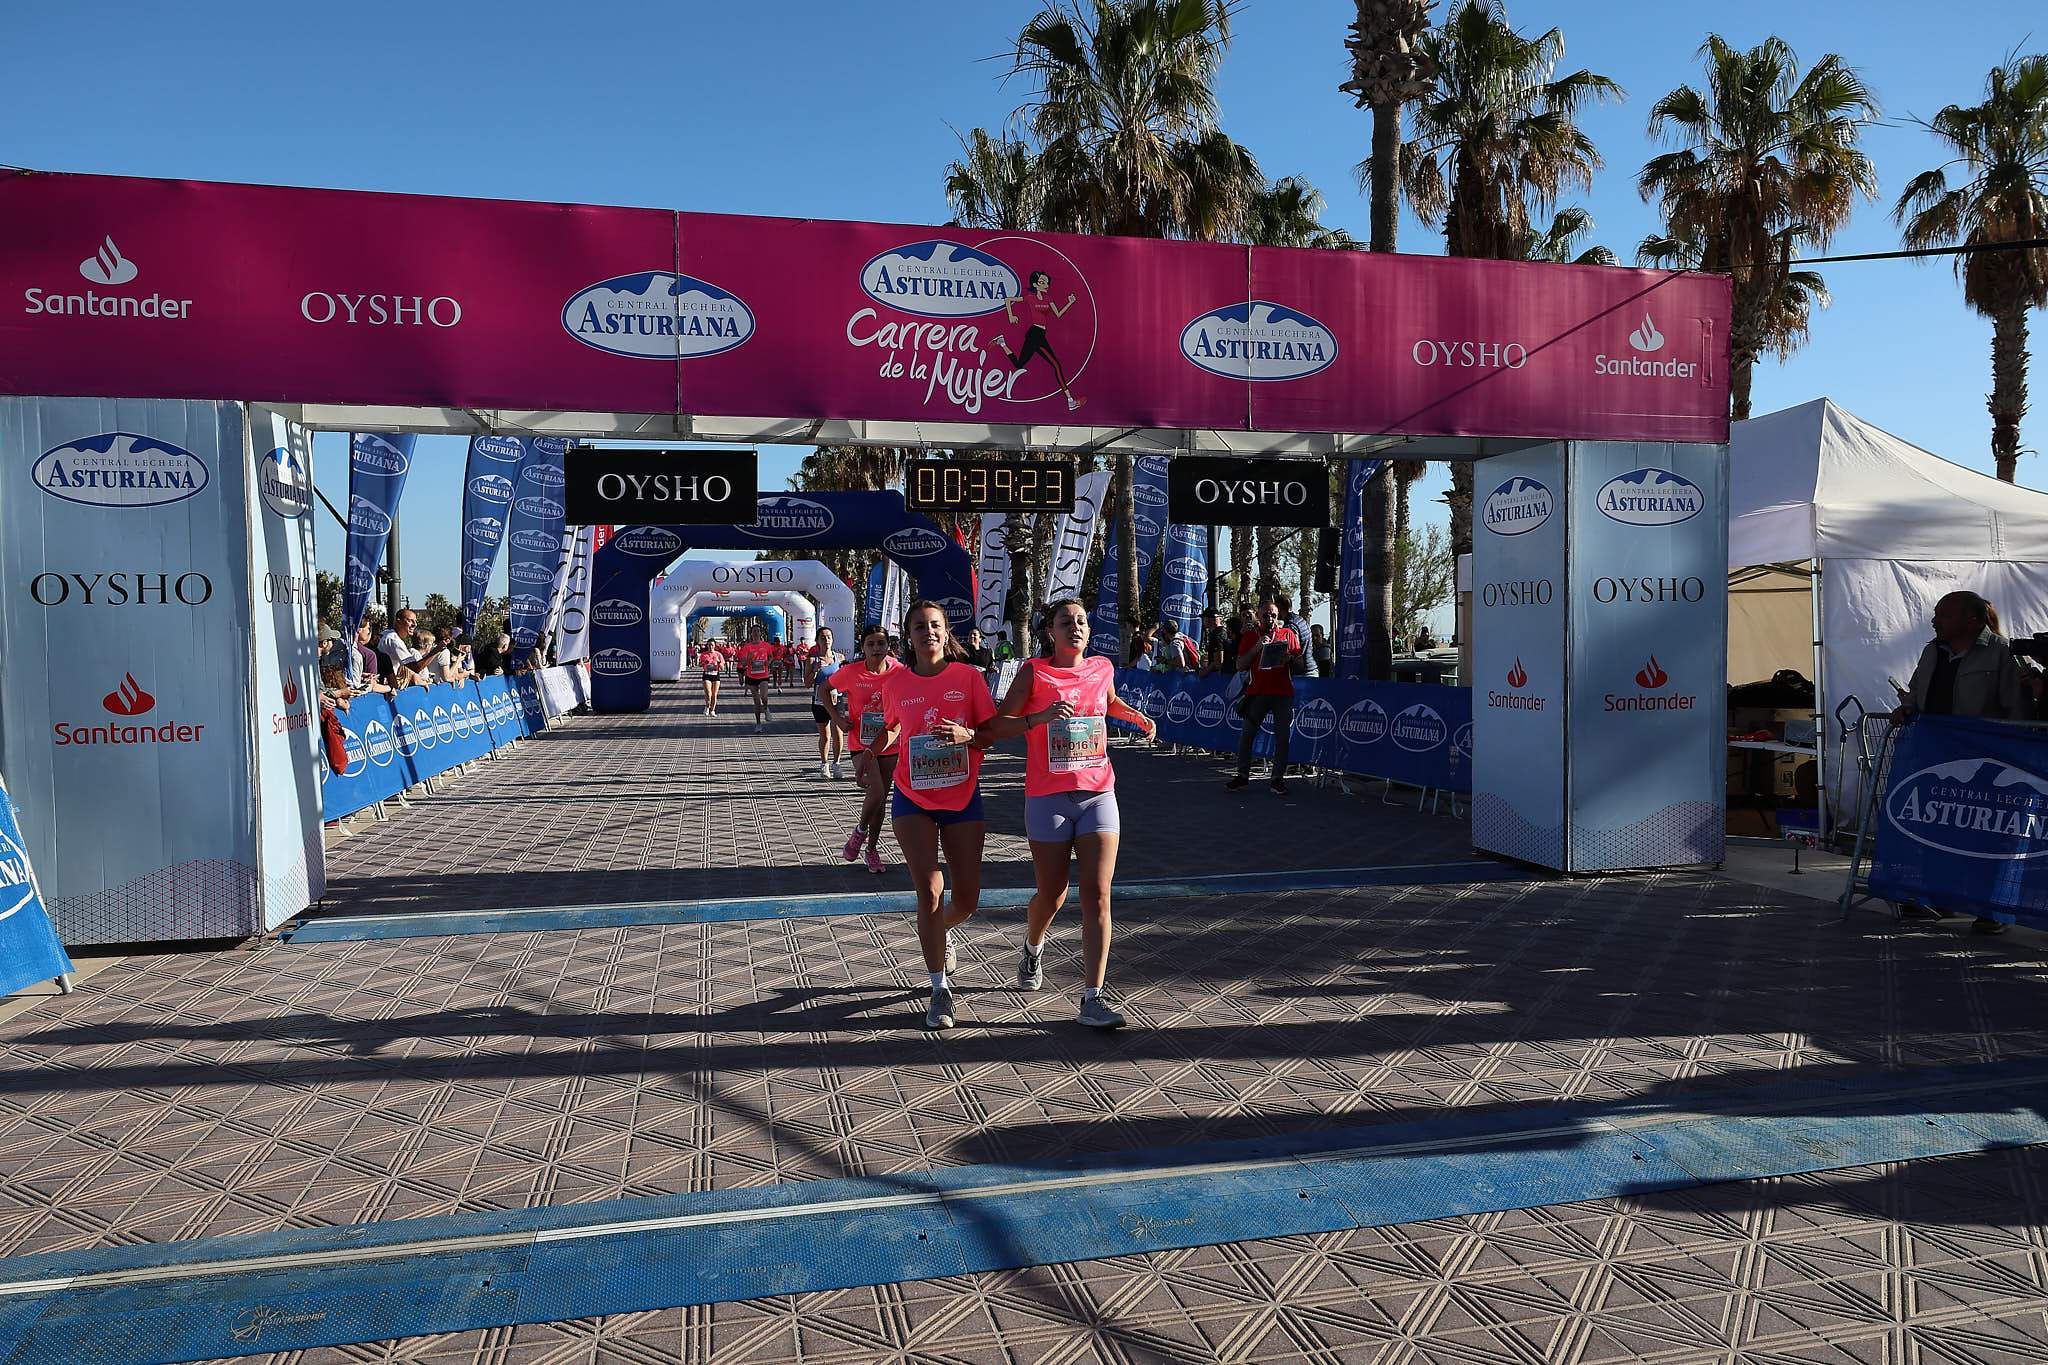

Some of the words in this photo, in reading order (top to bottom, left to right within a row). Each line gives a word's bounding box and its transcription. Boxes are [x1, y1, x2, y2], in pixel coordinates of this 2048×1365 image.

[872, 264, 1009, 300] ASTURIANA
[898, 264, 949, 275] CENTRAL
[952, 267, 1005, 278] LECHERA
[25, 287, 193, 319] Santander
[301, 291, 462, 327] OYSHO
[607, 299, 668, 311] CENTRAL
[673, 301, 735, 313] ECHERA
[577, 300, 741, 338] ASTURIANA
[846, 307, 980, 353] Carrera
[1192, 327, 1326, 362] ASTURIANA
[1216, 327, 1267, 337] CENTRAL
[1271, 329, 1322, 340] LECHERA
[1412, 339, 1528, 369] OYSHO
[1594, 354, 1697, 378] Santander
[879, 351, 904, 378] de
[909, 351, 928, 380] la
[923, 349, 1028, 414] Mujer
[45, 459, 197, 489] ASTURIANA
[73, 458, 129, 467] CENTRAL
[135, 458, 190, 467] LECHERA
[597, 473, 732, 502] OYSHO
[917, 468, 1063, 504] 00:39:23
[1194, 478, 1308, 506] OYSHO
[1486, 500, 1549, 525] ASTURIANA
[1603, 489, 1697, 513] ASTURIANA
[753, 515, 827, 529] STURIANA
[513, 534, 555, 549] ASTURIANA
[619, 537, 677, 549] ASTURIANA
[888, 539, 944, 551] ASTURIANA
[711, 566, 794, 584] OYSHO
[30, 571, 213, 607] OYSHO
[263, 571, 311, 606] OYSHO
[1482, 578, 1554, 608] OYSHO
[1593, 576, 1705, 604] OYSHO
[593, 610, 639, 620] ASTURIANA
[593, 658, 639, 669] ASTURIANA
[1487, 690, 1546, 712] Santander
[1604, 693, 1697, 712] Santander
[53, 720, 205, 746] Santander
[272, 711, 312, 736] Santander
[1341, 715, 1383, 734] ASTURIANA
[1393, 719, 1440, 742] ASTURIANA
[1930, 786, 1990, 801] CENTRAL
